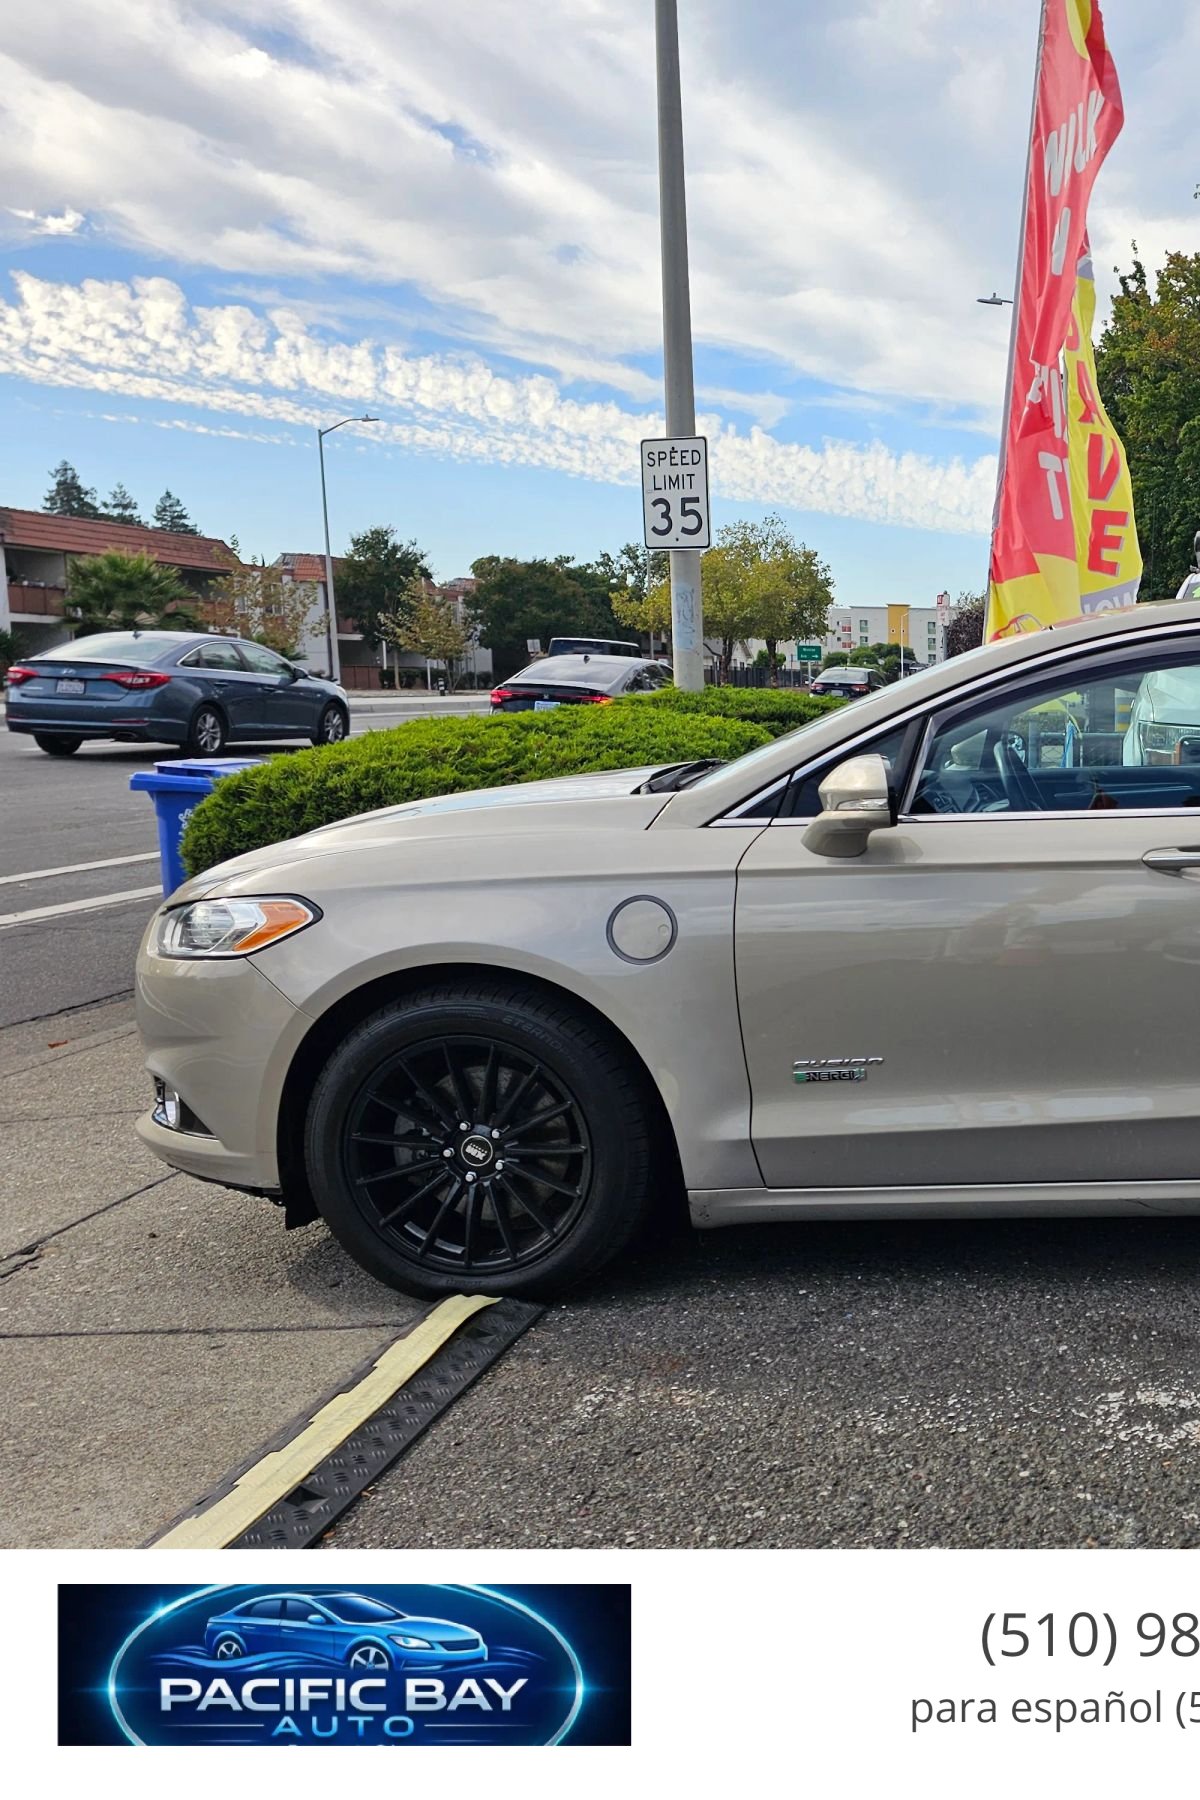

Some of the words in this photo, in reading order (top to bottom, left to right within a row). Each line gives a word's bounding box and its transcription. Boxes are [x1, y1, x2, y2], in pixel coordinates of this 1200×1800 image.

[647, 449, 701, 467] SPEED
[653, 473, 695, 490] LIMIT
[651, 496, 703, 536] 35
